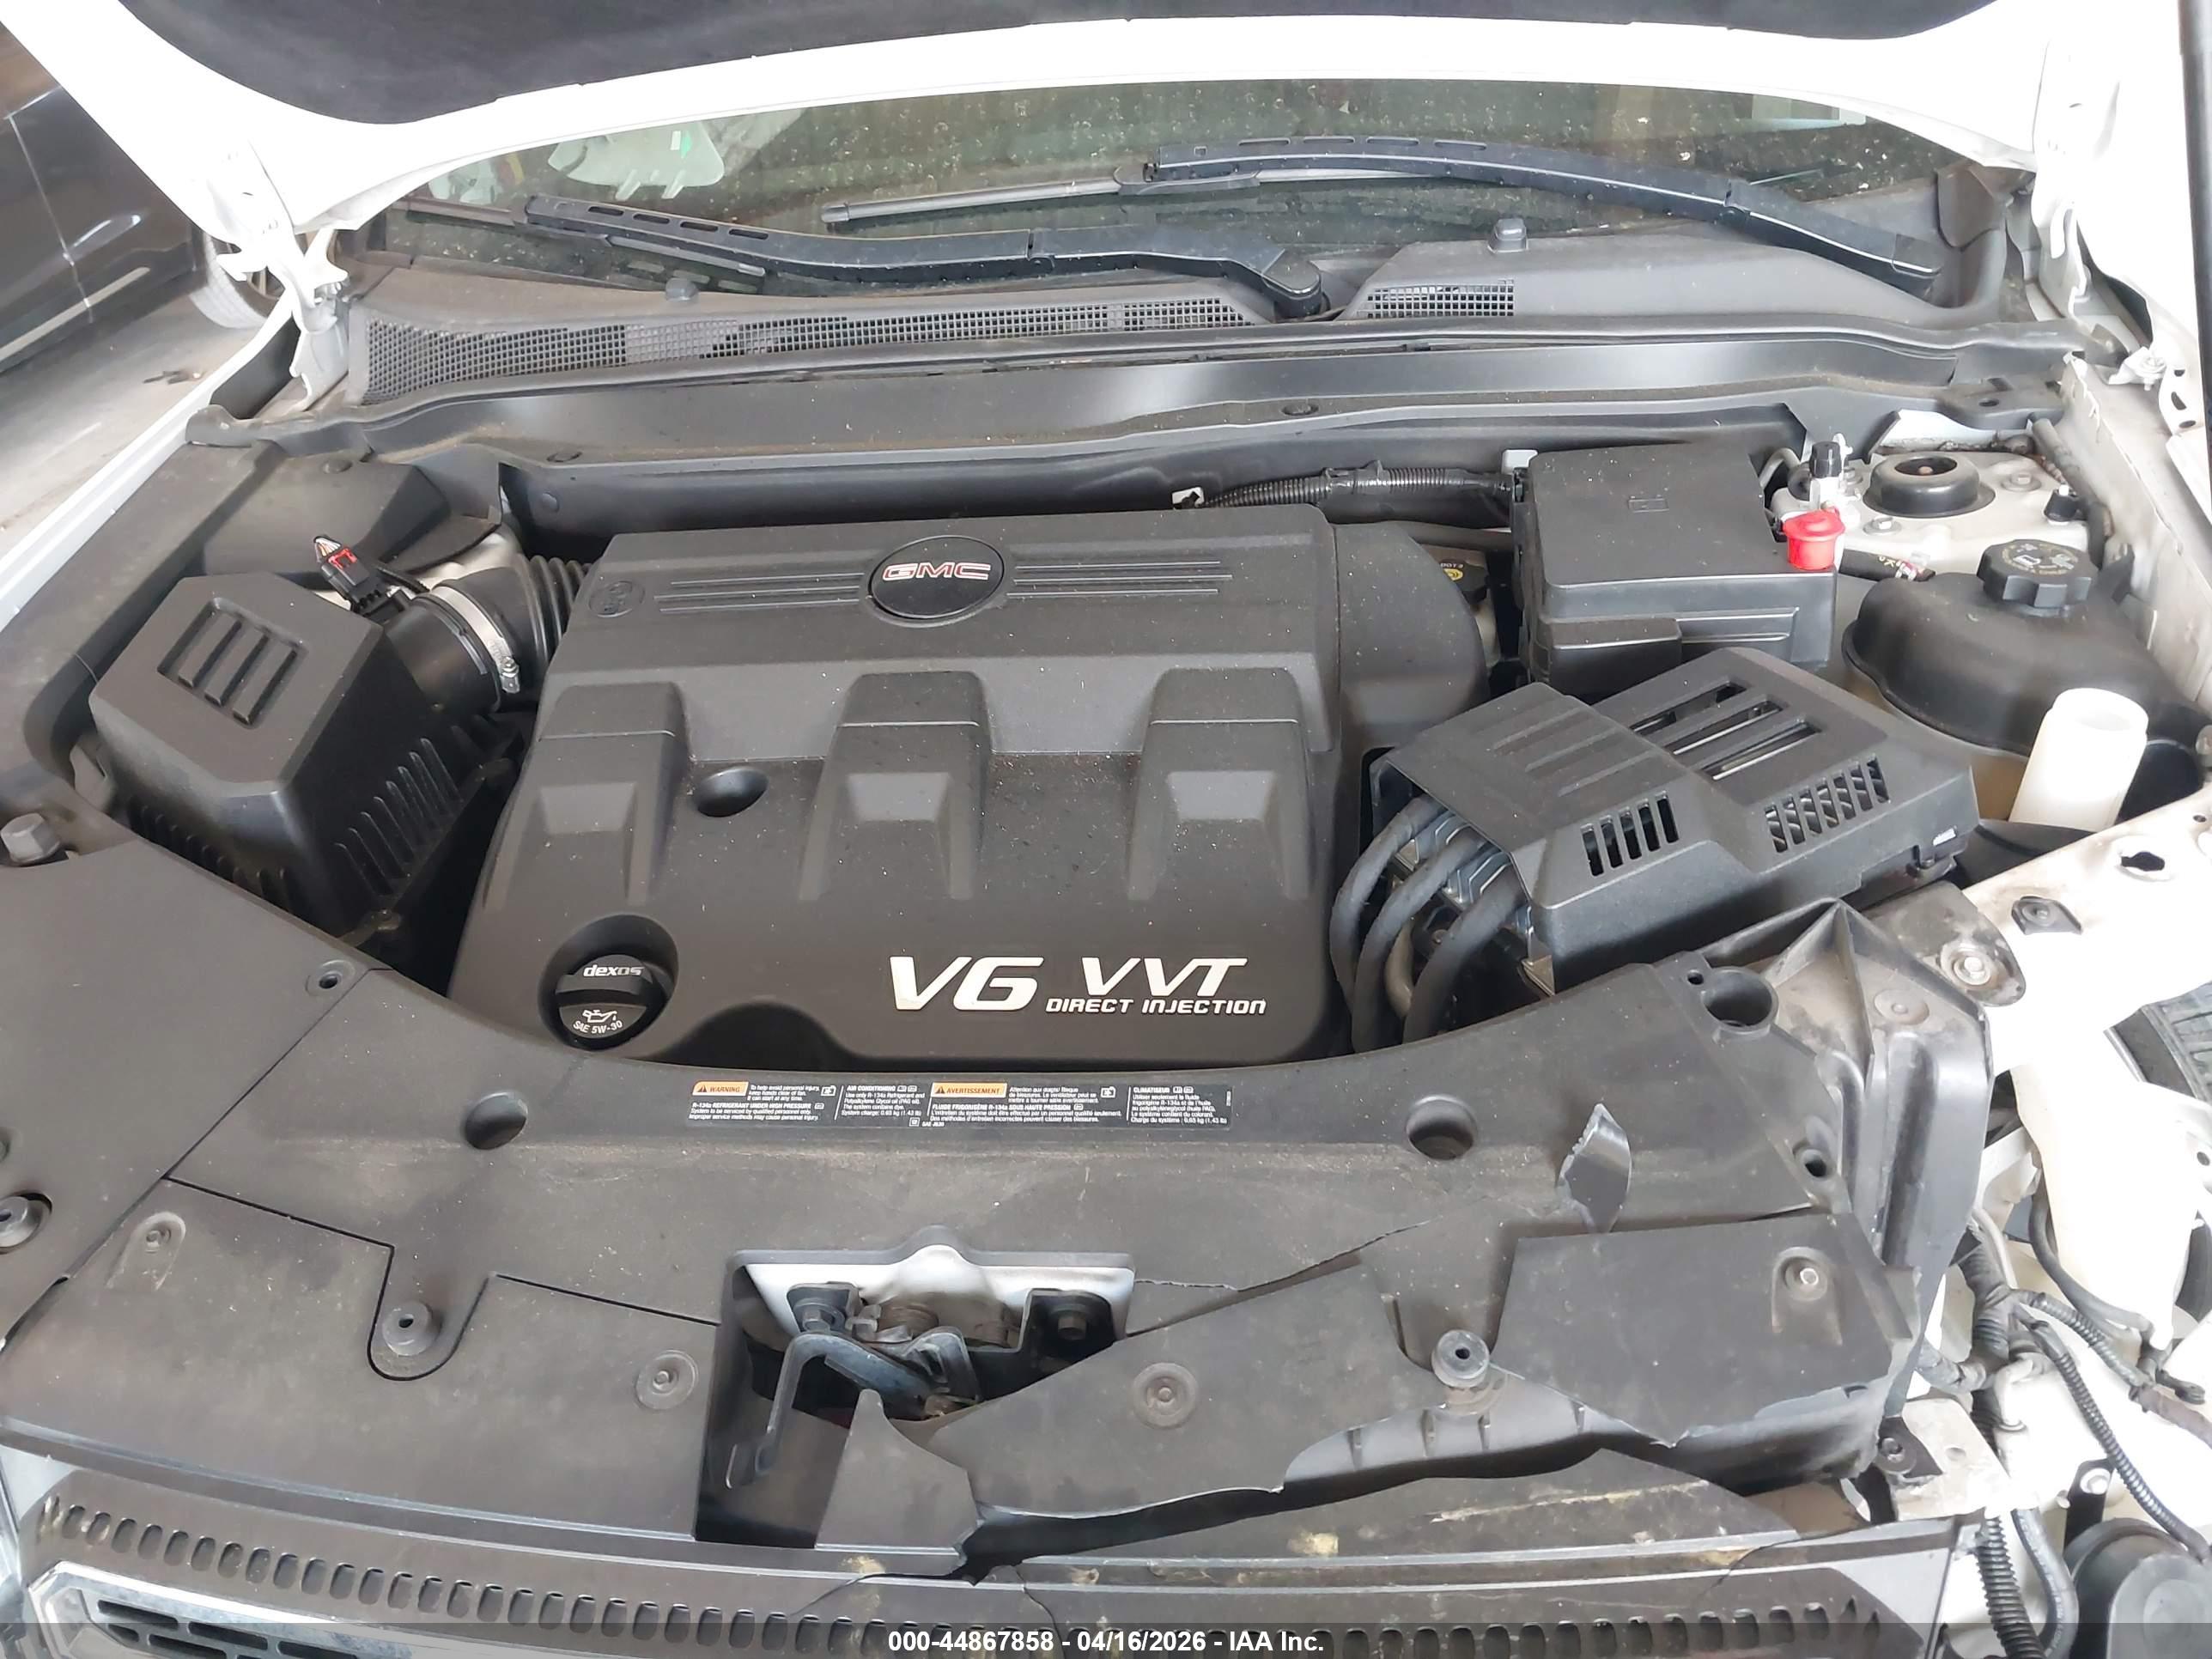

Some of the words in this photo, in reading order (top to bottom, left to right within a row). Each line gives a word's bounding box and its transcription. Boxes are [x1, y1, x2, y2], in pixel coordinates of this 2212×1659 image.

[883, 562, 991, 580] GMC
[583, 964, 645, 977] dexos
[889, 956, 1044, 1011] V6
[1081, 957, 1249, 997] VVT
[1045, 998, 1134, 1013] DIRECT
[1141, 999, 1267, 1015] INJECTION
[573, 1020, 591, 1033] SAE
[592, 1020, 623, 1034] 5W-30
